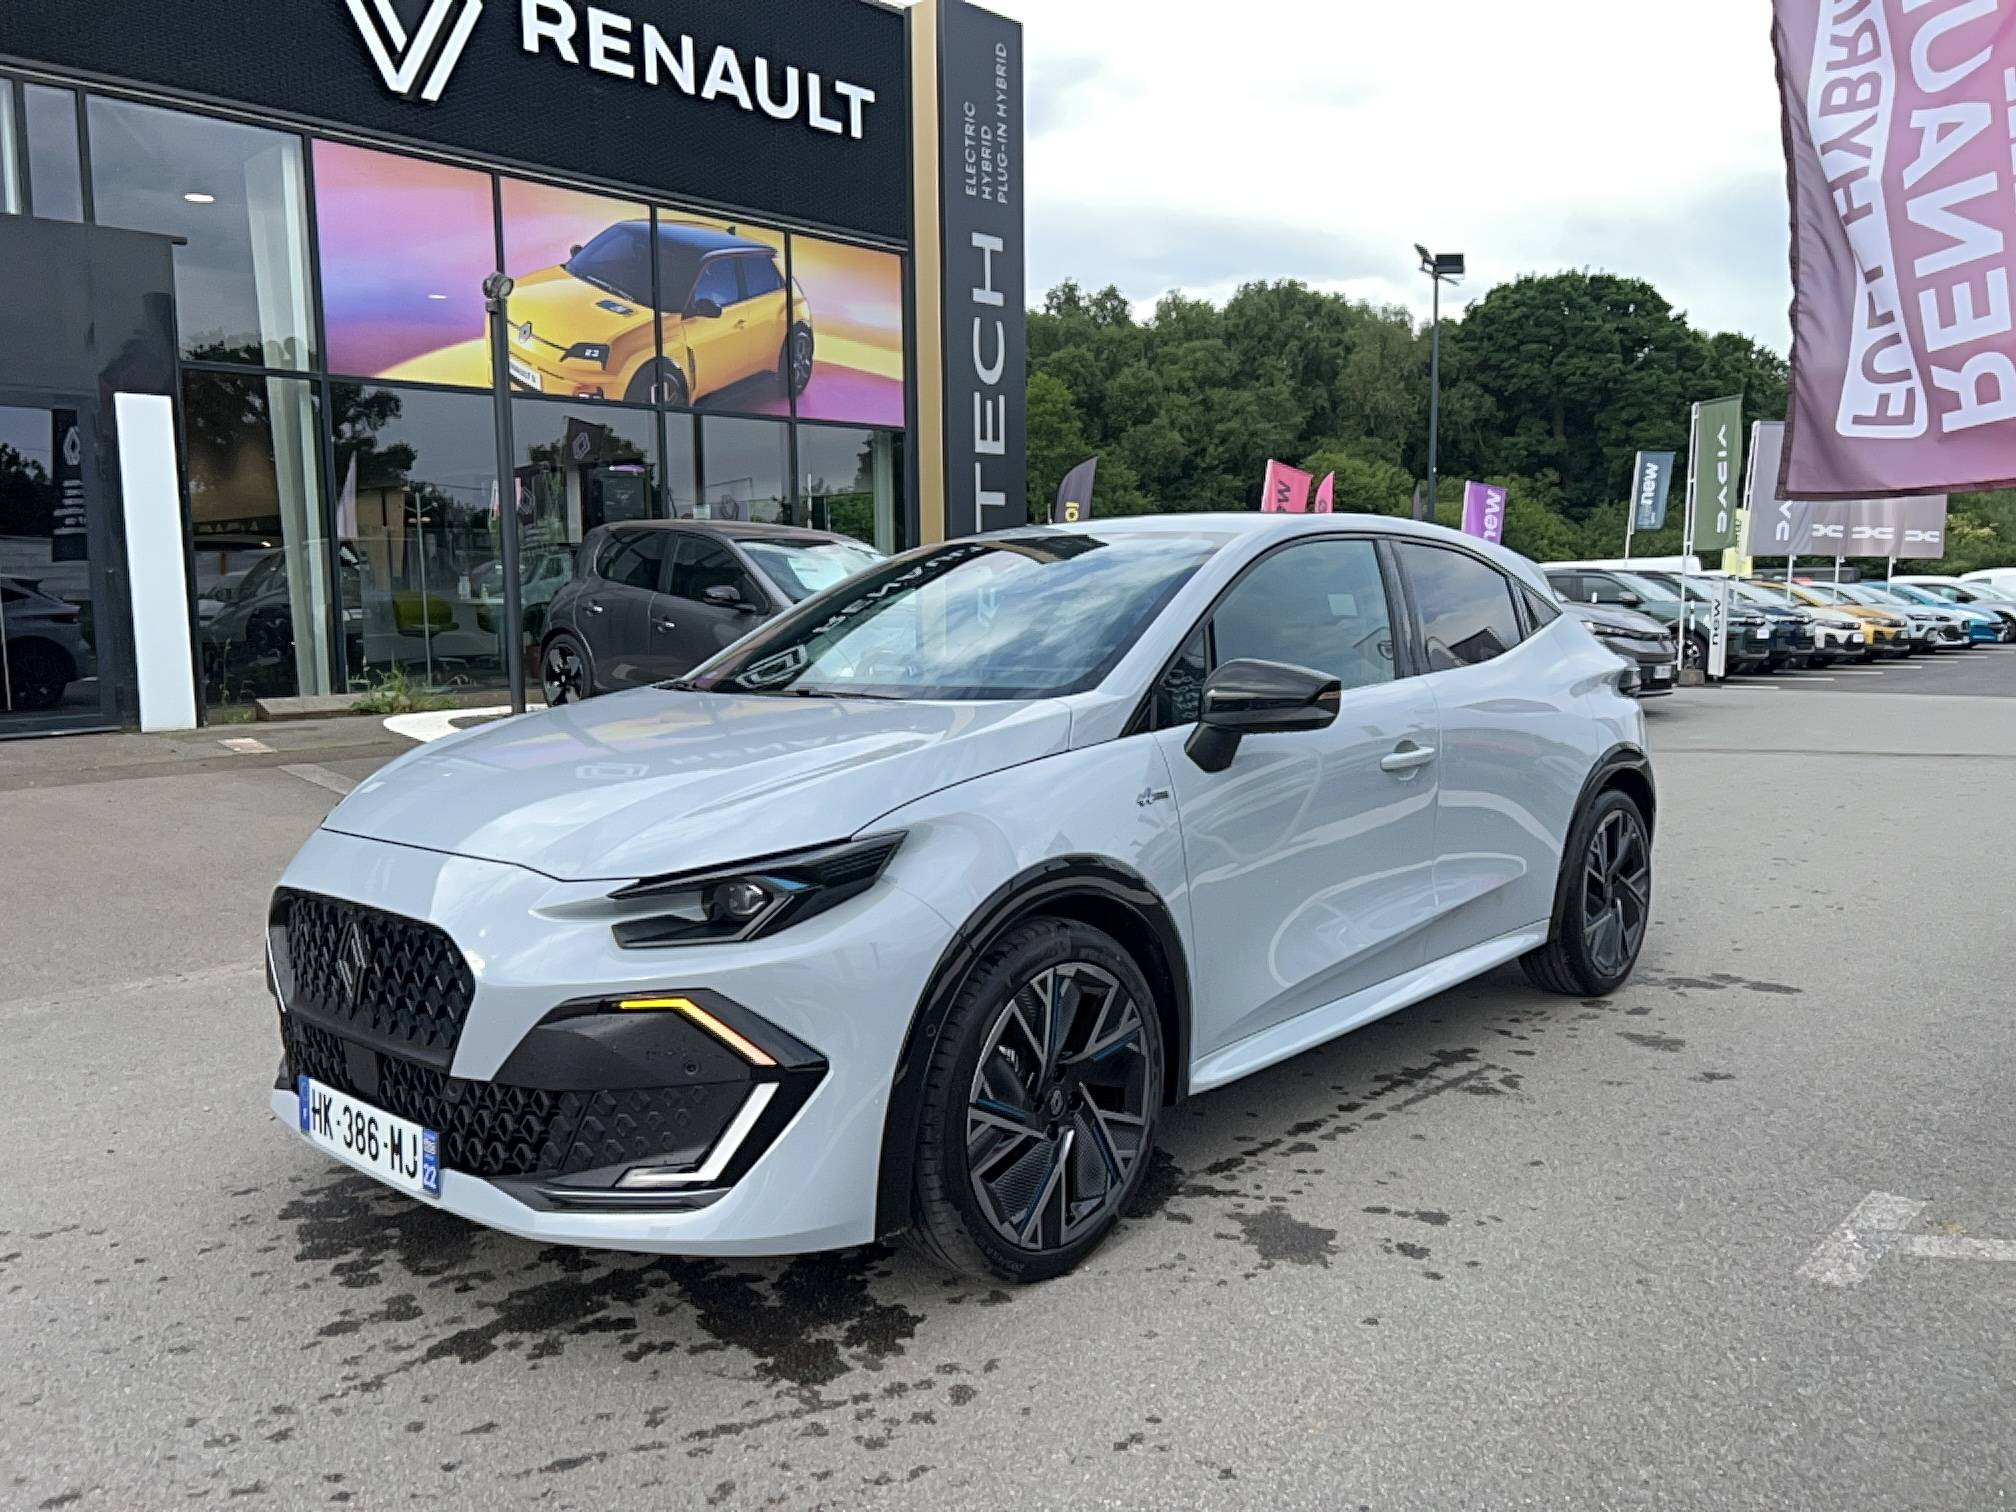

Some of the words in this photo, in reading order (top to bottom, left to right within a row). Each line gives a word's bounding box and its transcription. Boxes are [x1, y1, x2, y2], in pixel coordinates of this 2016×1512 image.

[520, 0, 876, 139] RENAULT
[995, 42, 1008, 118] HYBRID
[963, 101, 977, 196] ELECTRIC
[980, 124, 993, 200] HYBRID
[996, 122, 1009, 205] PLUG-IN
[971, 231, 1006, 534] TECH
[1483, 488, 1501, 539] new
[1640, 462, 1659, 506] new
[311, 1087, 419, 1179] HK-386-MJ
